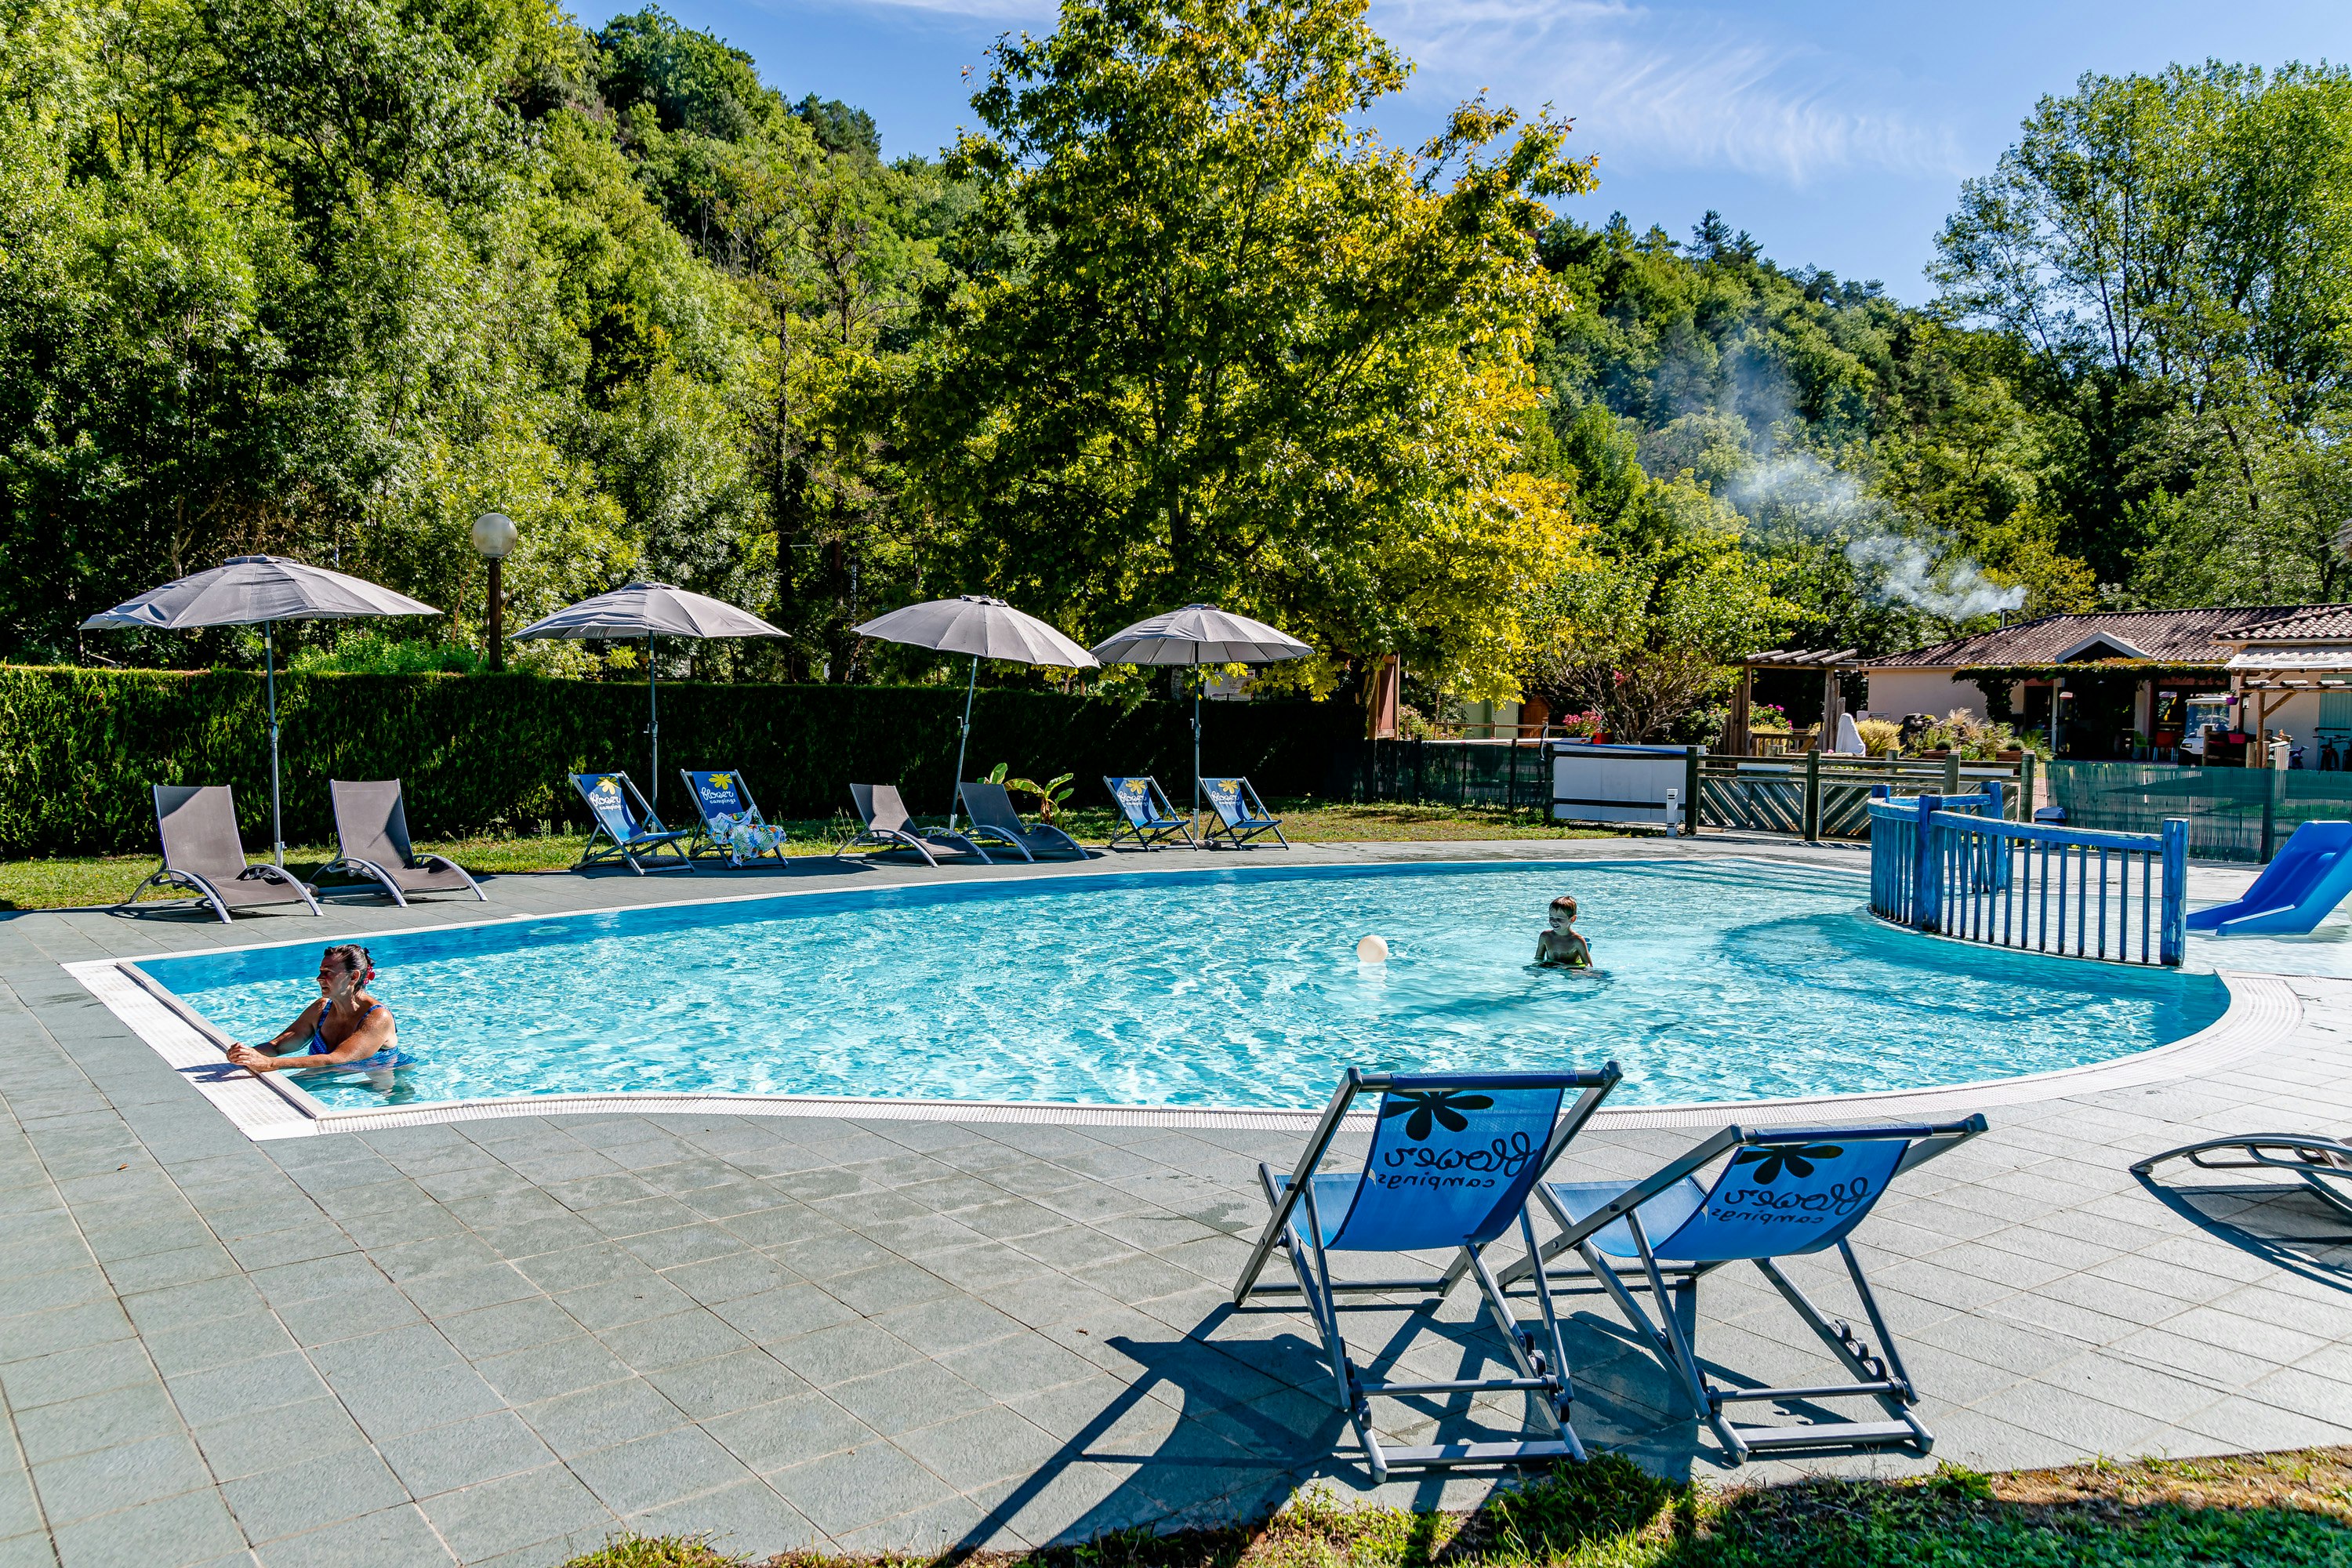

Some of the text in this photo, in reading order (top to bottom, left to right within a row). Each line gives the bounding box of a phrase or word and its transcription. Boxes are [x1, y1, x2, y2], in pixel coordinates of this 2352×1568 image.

[590, 792, 621, 807] flower
[700, 786, 734, 800] flower
[1117, 790, 1147, 803] flower
[1211, 790, 1239, 802] flower
